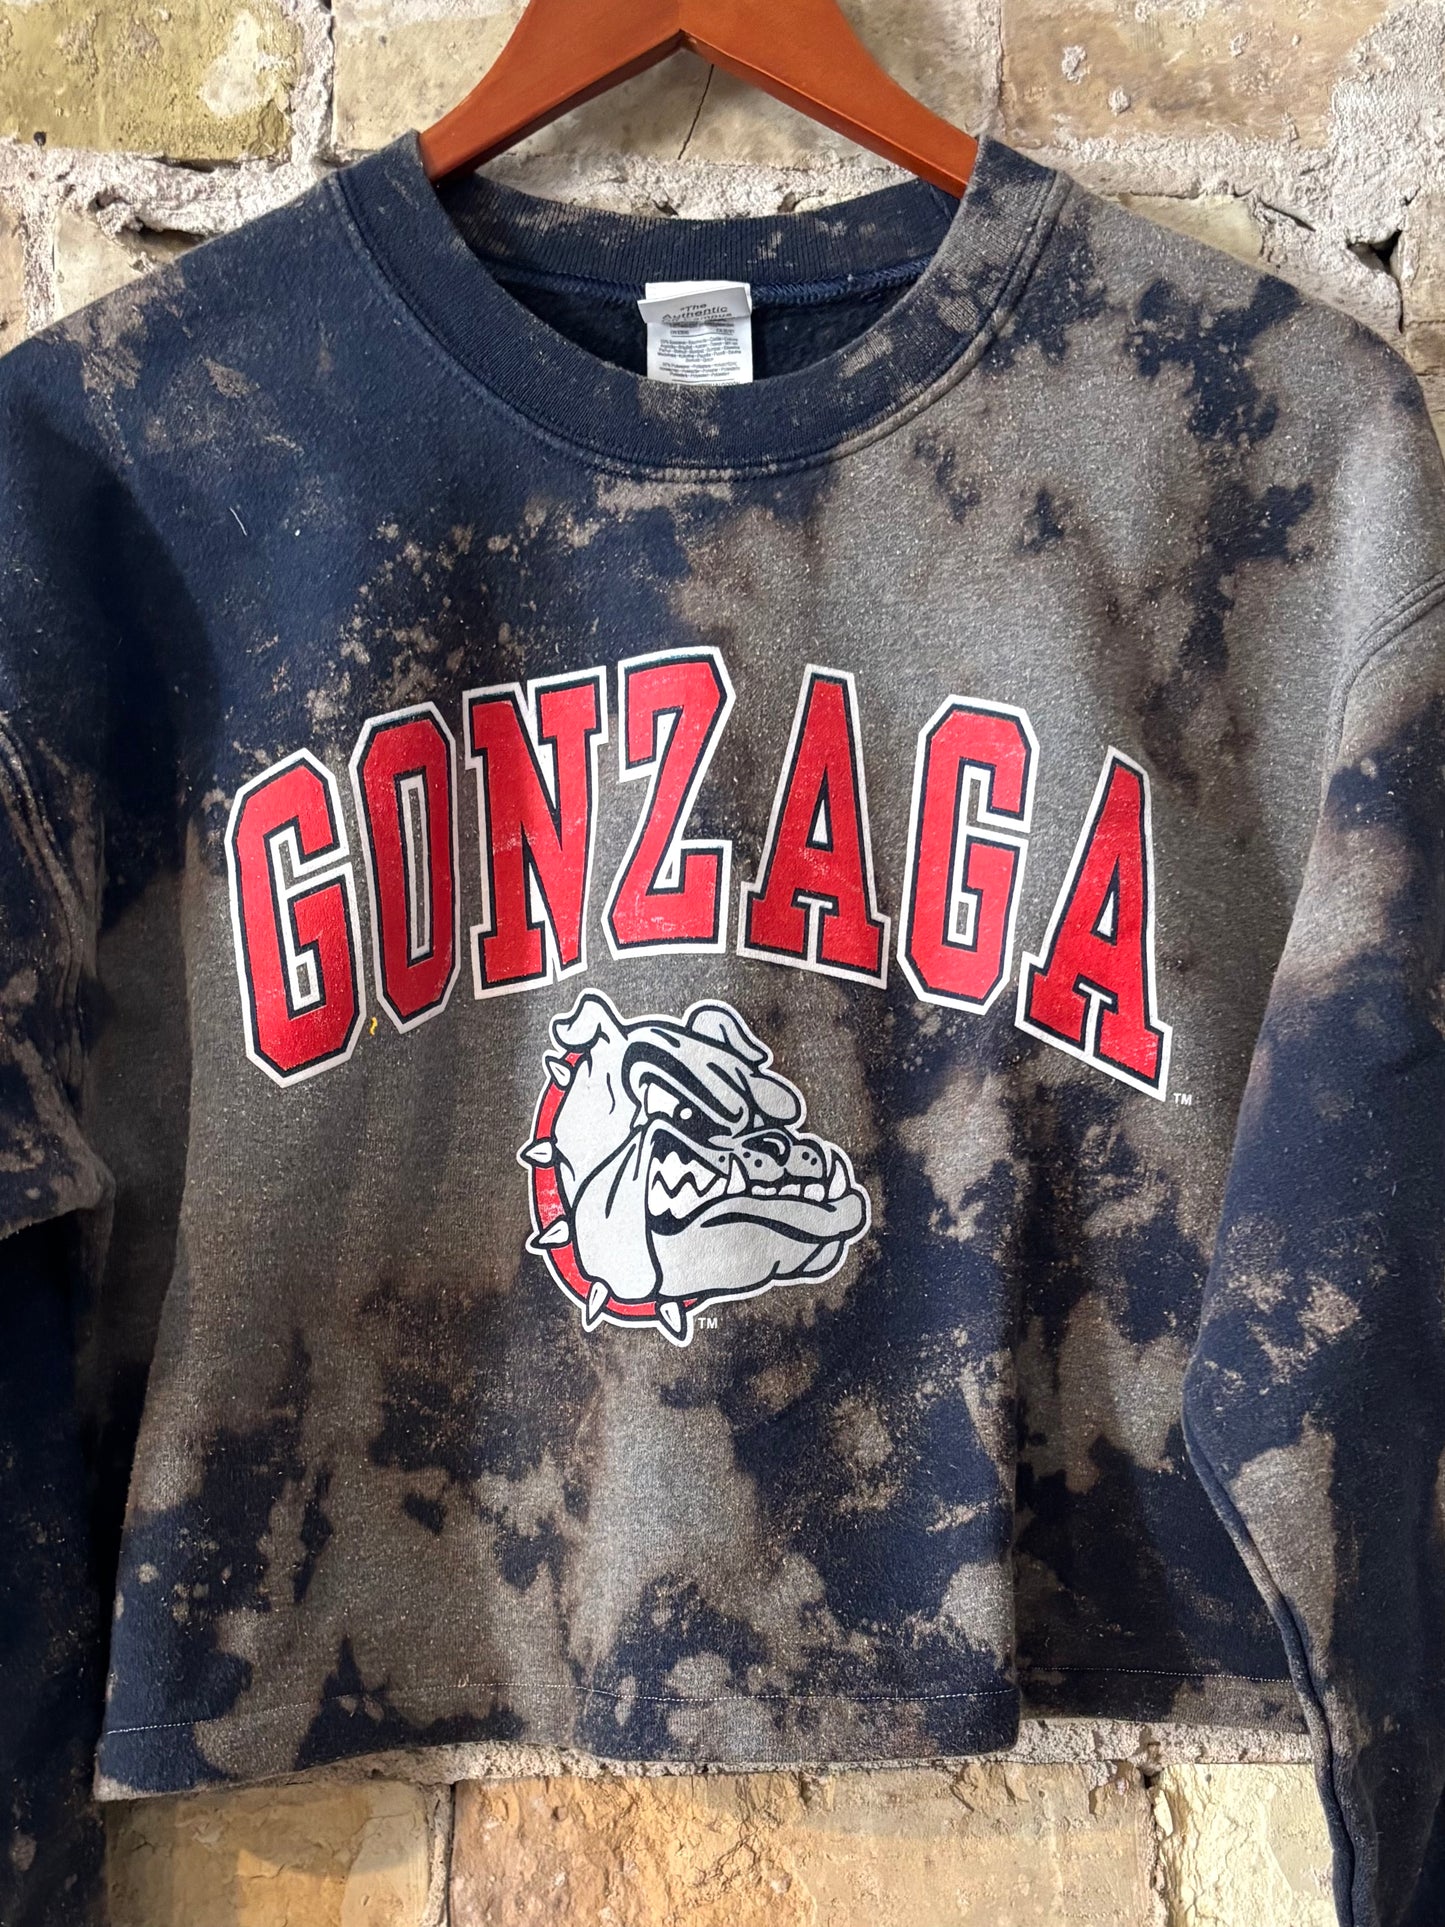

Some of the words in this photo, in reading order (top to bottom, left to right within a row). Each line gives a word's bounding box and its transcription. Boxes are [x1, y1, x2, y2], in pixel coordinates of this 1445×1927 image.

[662, 306, 728, 321] Authentic
[226, 646, 1172, 1101] GONZAGA
[1173, 1092, 1192, 1106] TM
[697, 1317, 718, 1330] TM
